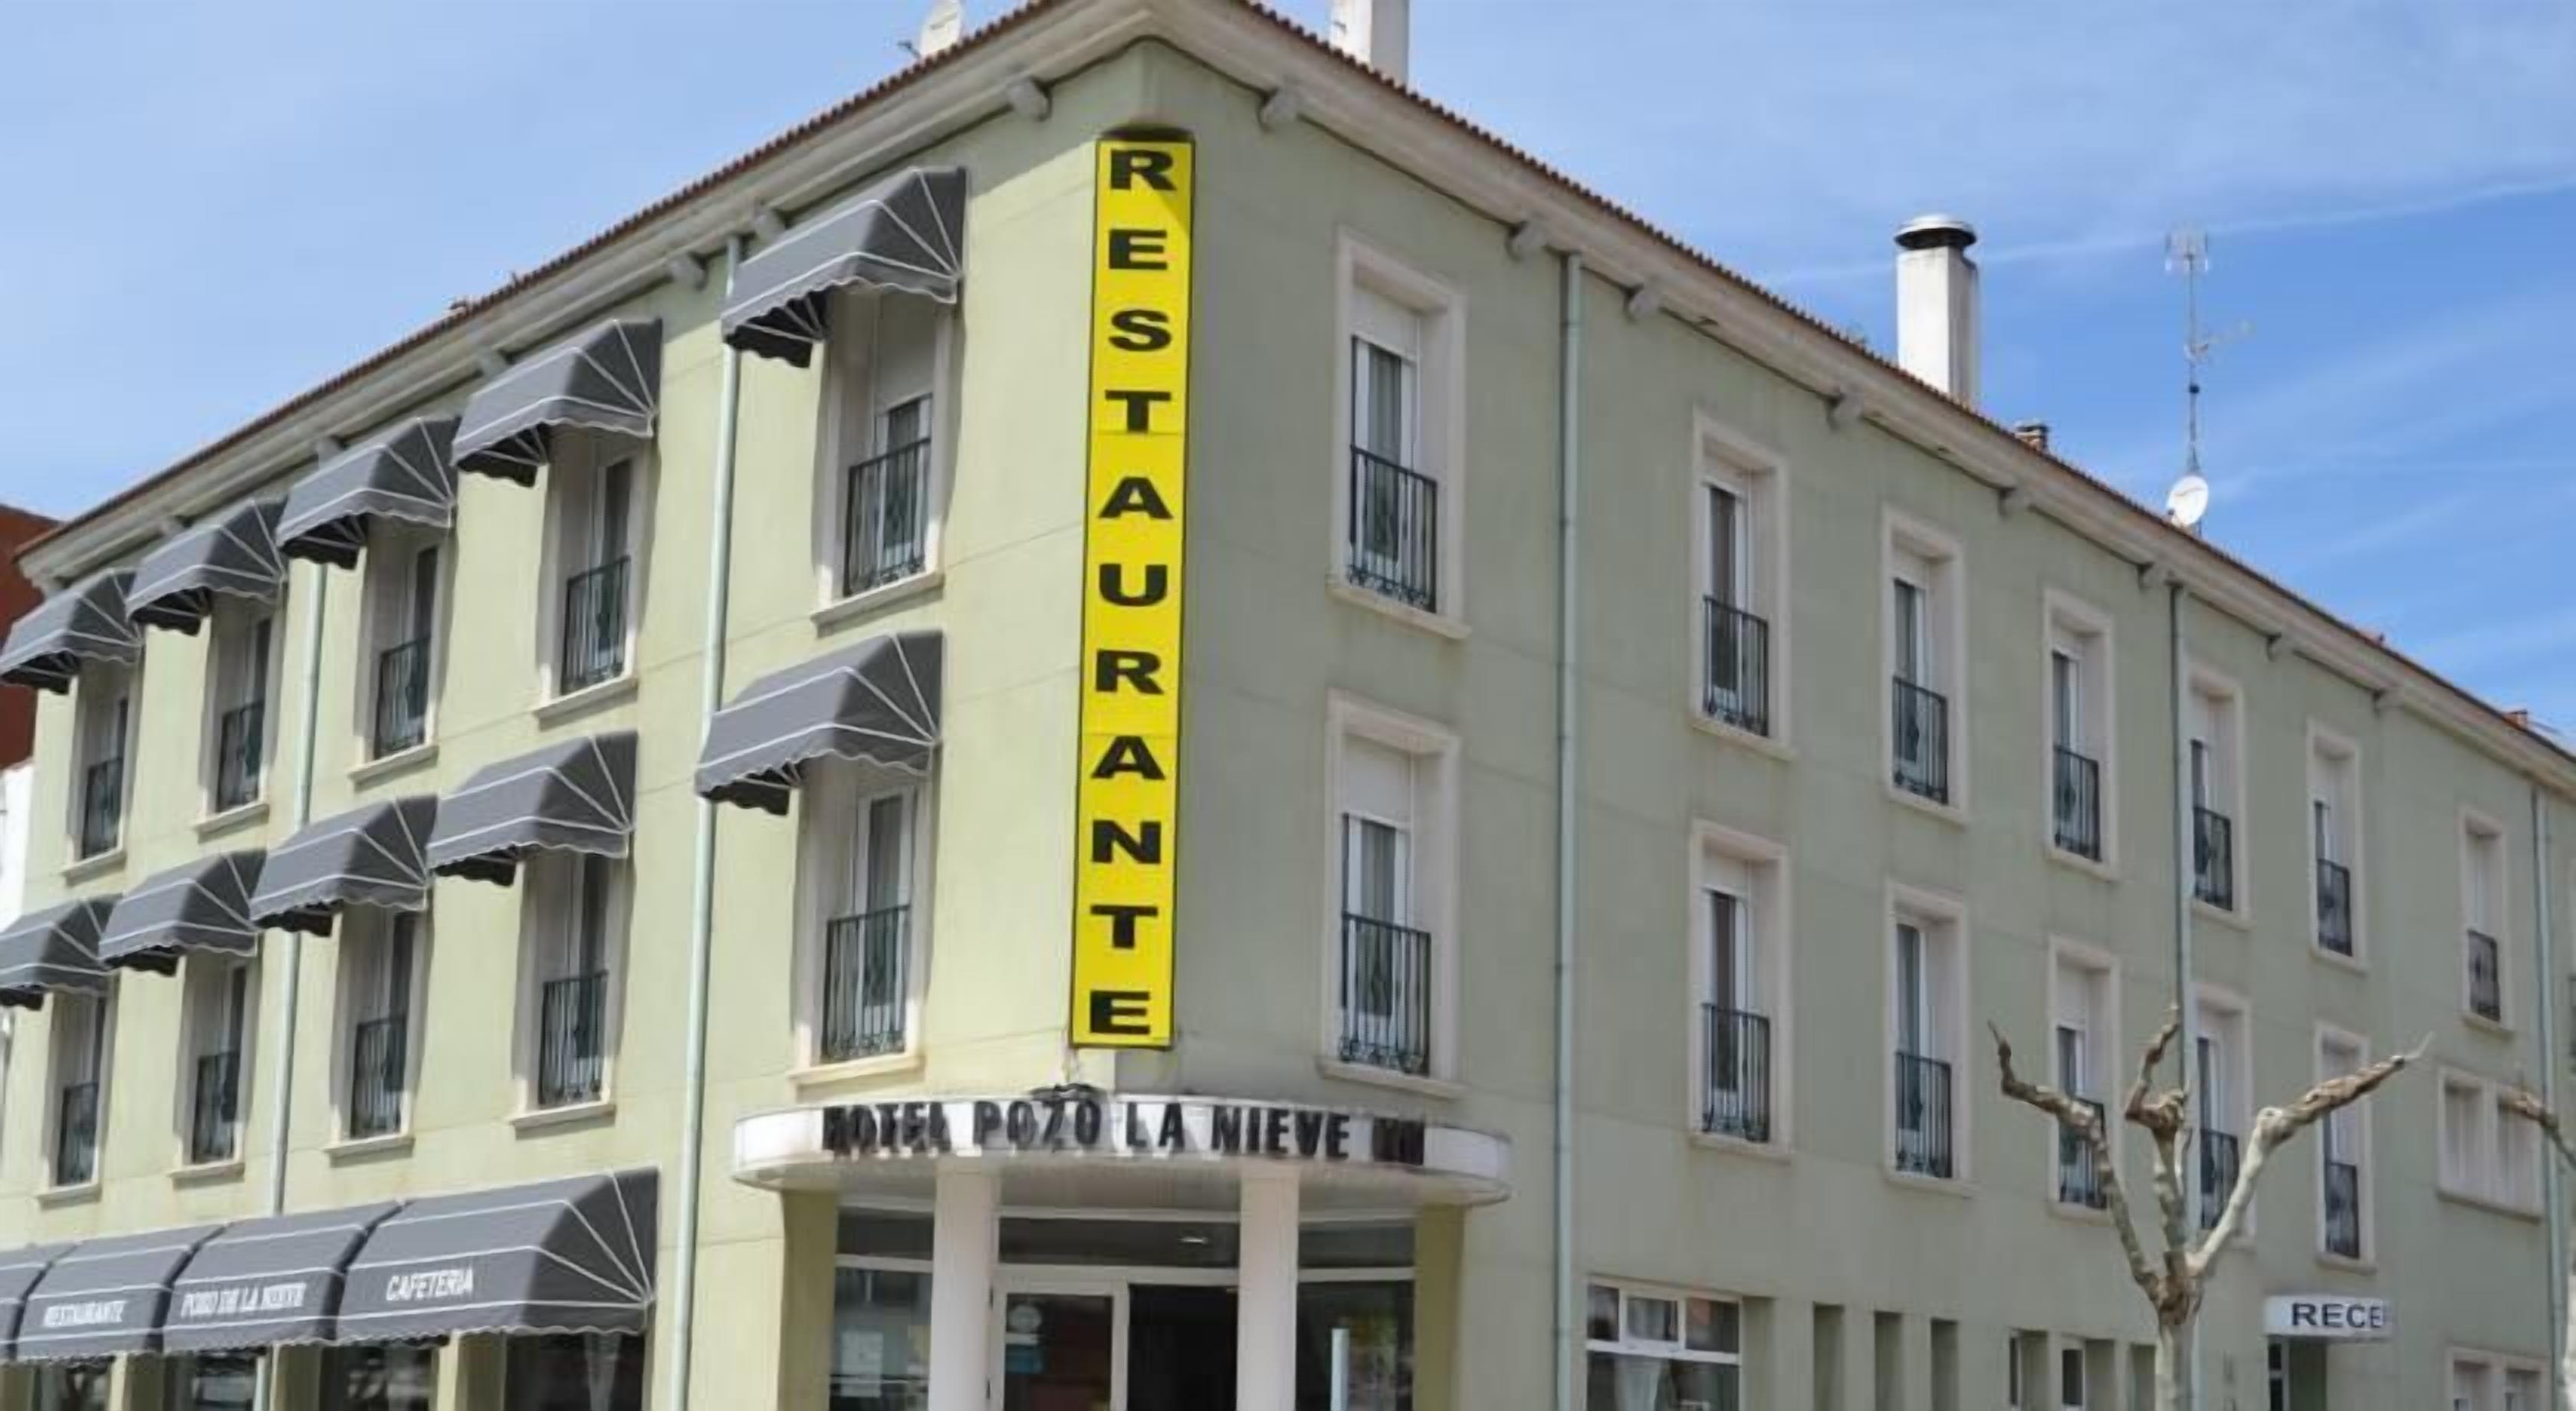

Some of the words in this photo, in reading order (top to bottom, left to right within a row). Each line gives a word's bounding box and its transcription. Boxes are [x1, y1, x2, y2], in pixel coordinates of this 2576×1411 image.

[1088, 148, 1178, 1038] RESTAURANTE
[823, 1103, 951, 1156] HOTEL
[974, 1100, 1102, 1152] POZO
[1126, 1101, 1185, 1148] LA
[1211, 1104, 1350, 1160] NIEVE
[386, 1268, 474, 1301] CAFETERIA
